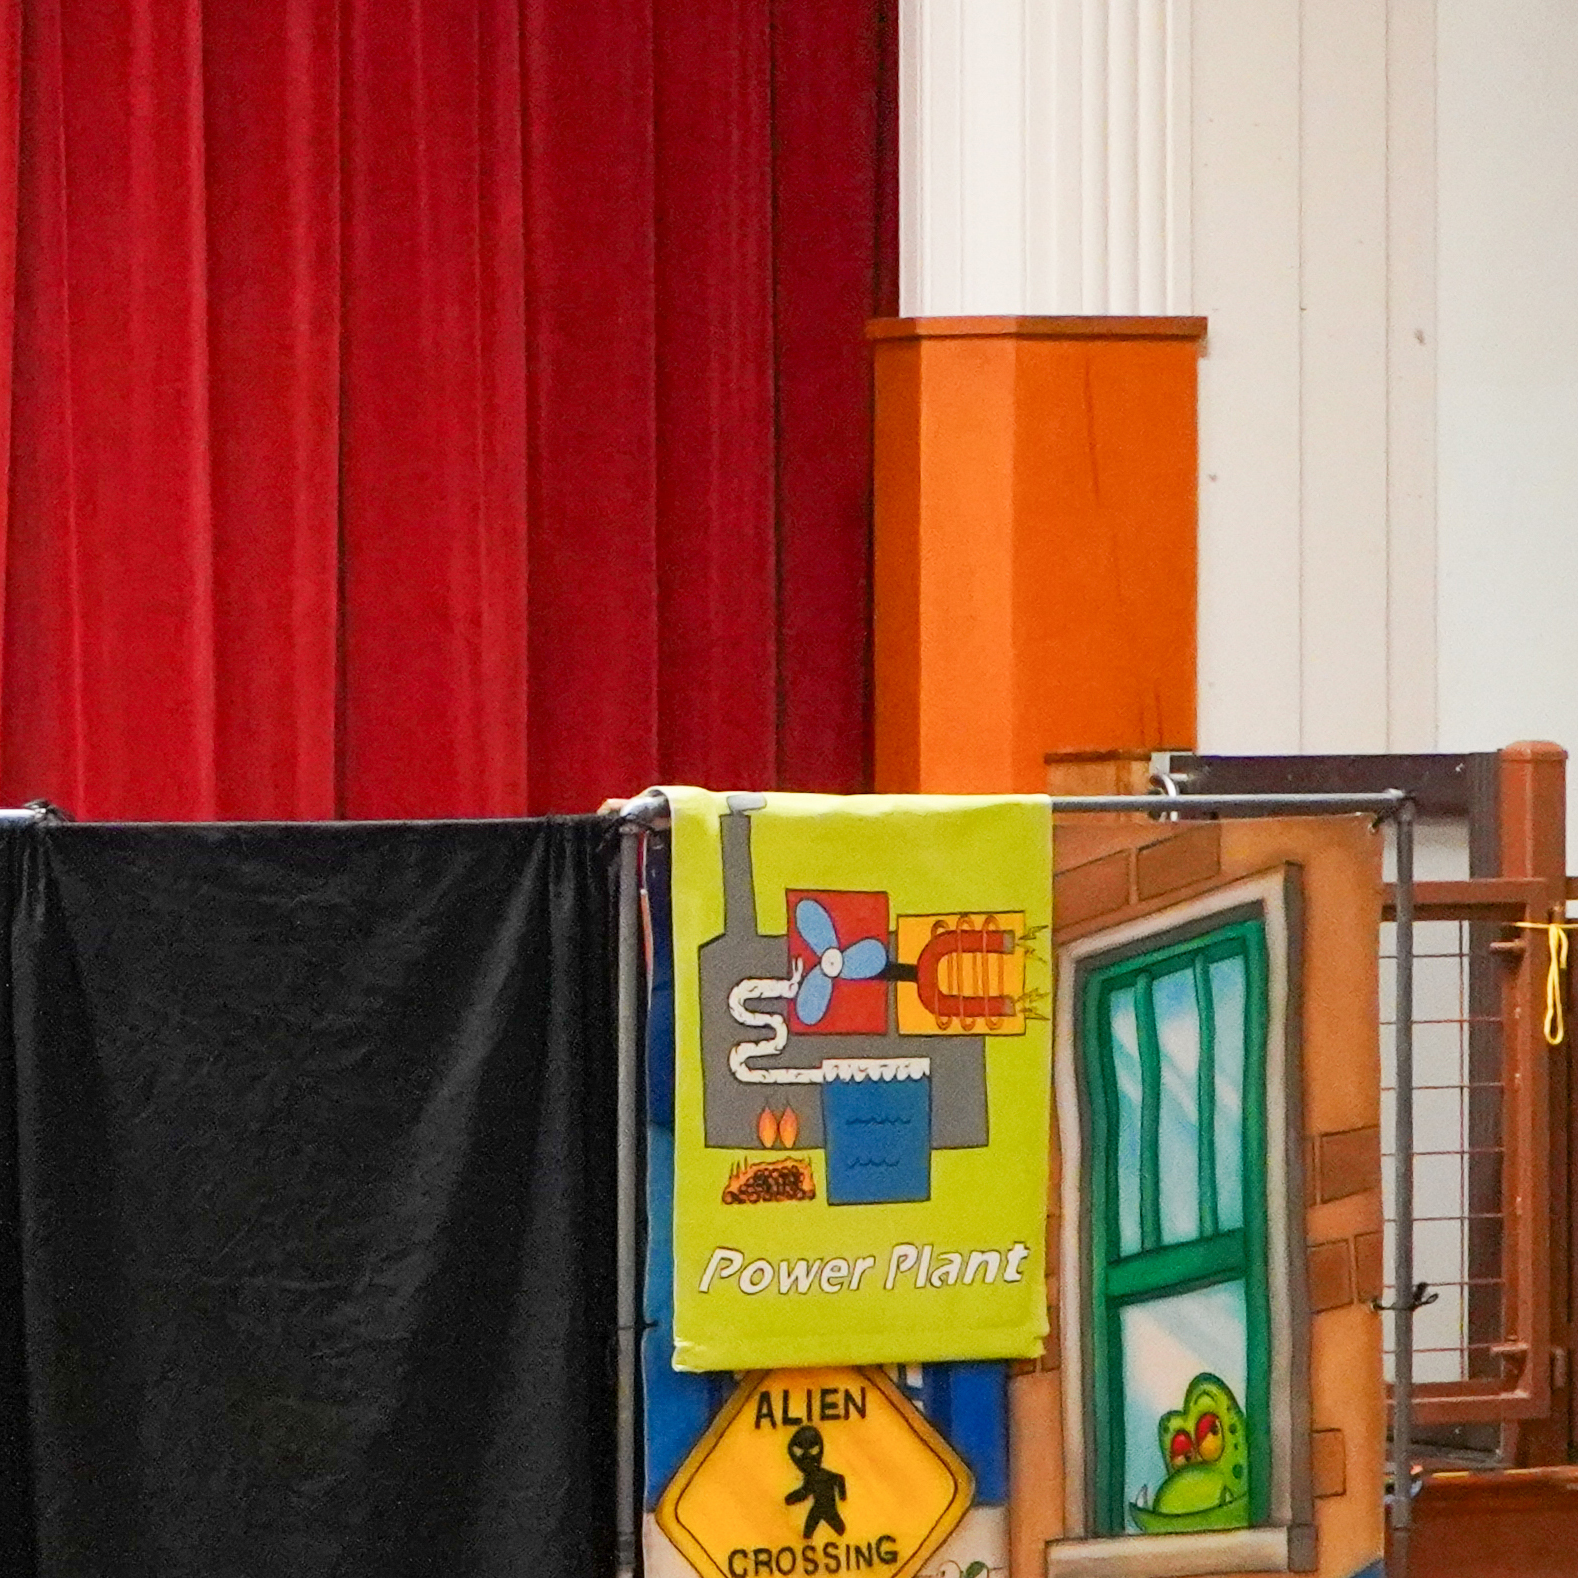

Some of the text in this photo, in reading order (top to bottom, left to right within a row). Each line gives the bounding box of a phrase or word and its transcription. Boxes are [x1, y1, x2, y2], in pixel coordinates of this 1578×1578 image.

[698, 1241, 1030, 1295] Power Plant
[754, 1386, 867, 1430] ALIEN
[727, 1535, 898, 1578] CROSSING
